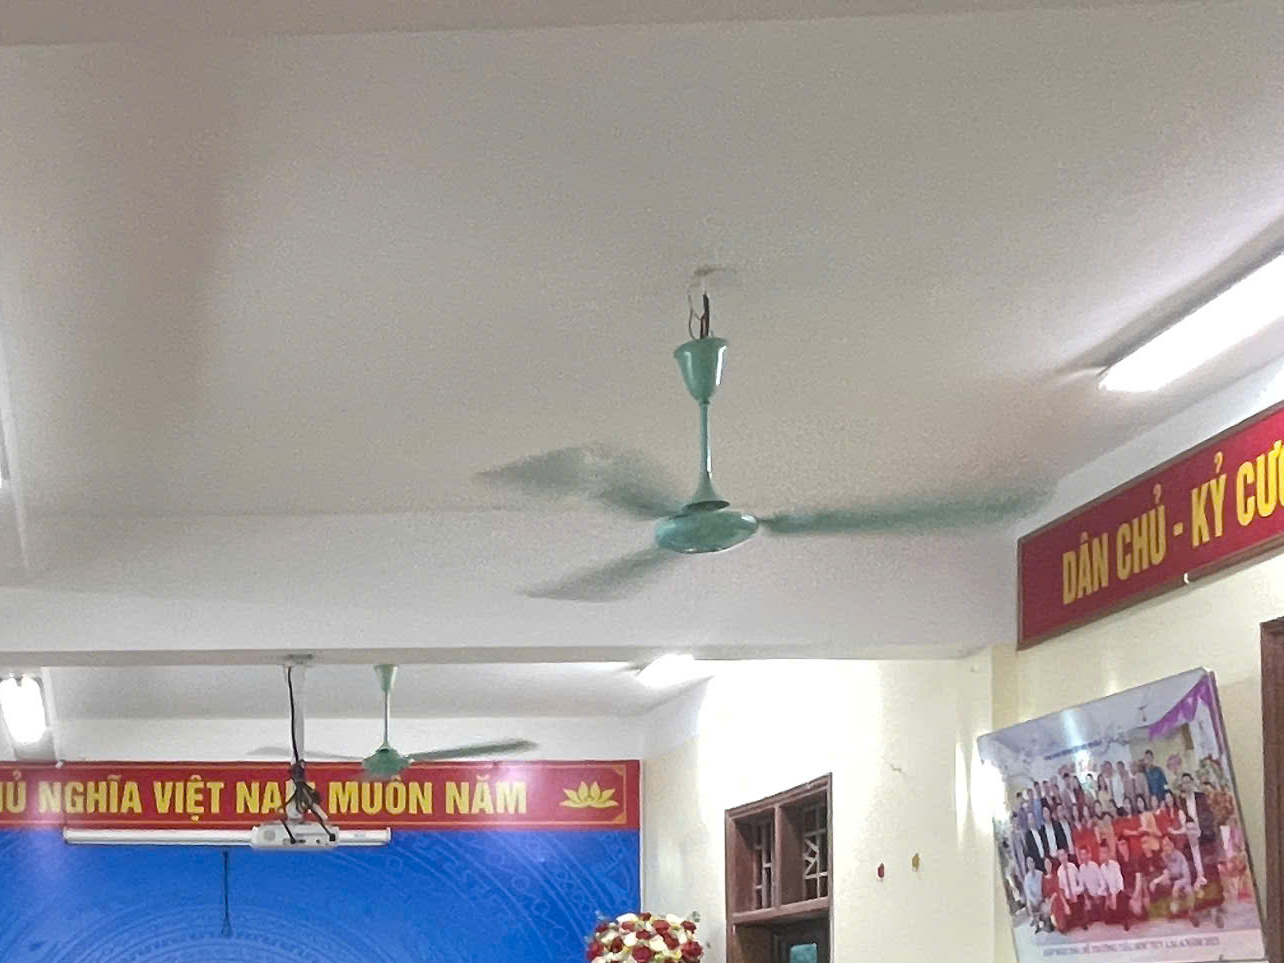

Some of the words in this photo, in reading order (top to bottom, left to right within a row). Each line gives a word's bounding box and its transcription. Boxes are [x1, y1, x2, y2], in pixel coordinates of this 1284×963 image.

[1062, 531, 1109, 605] DÂN
[1115, 484, 1166, 580] CHỦ
[1191, 451, 1227, 548] KỶ
[1235, 439, 1284, 527] CƯ
[37, 774, 143, 814] NGHĨA
[153, 774, 225, 822] VIỆT
[328, 775, 433, 815] MUÔN
[445, 774, 528, 815] NĂM
